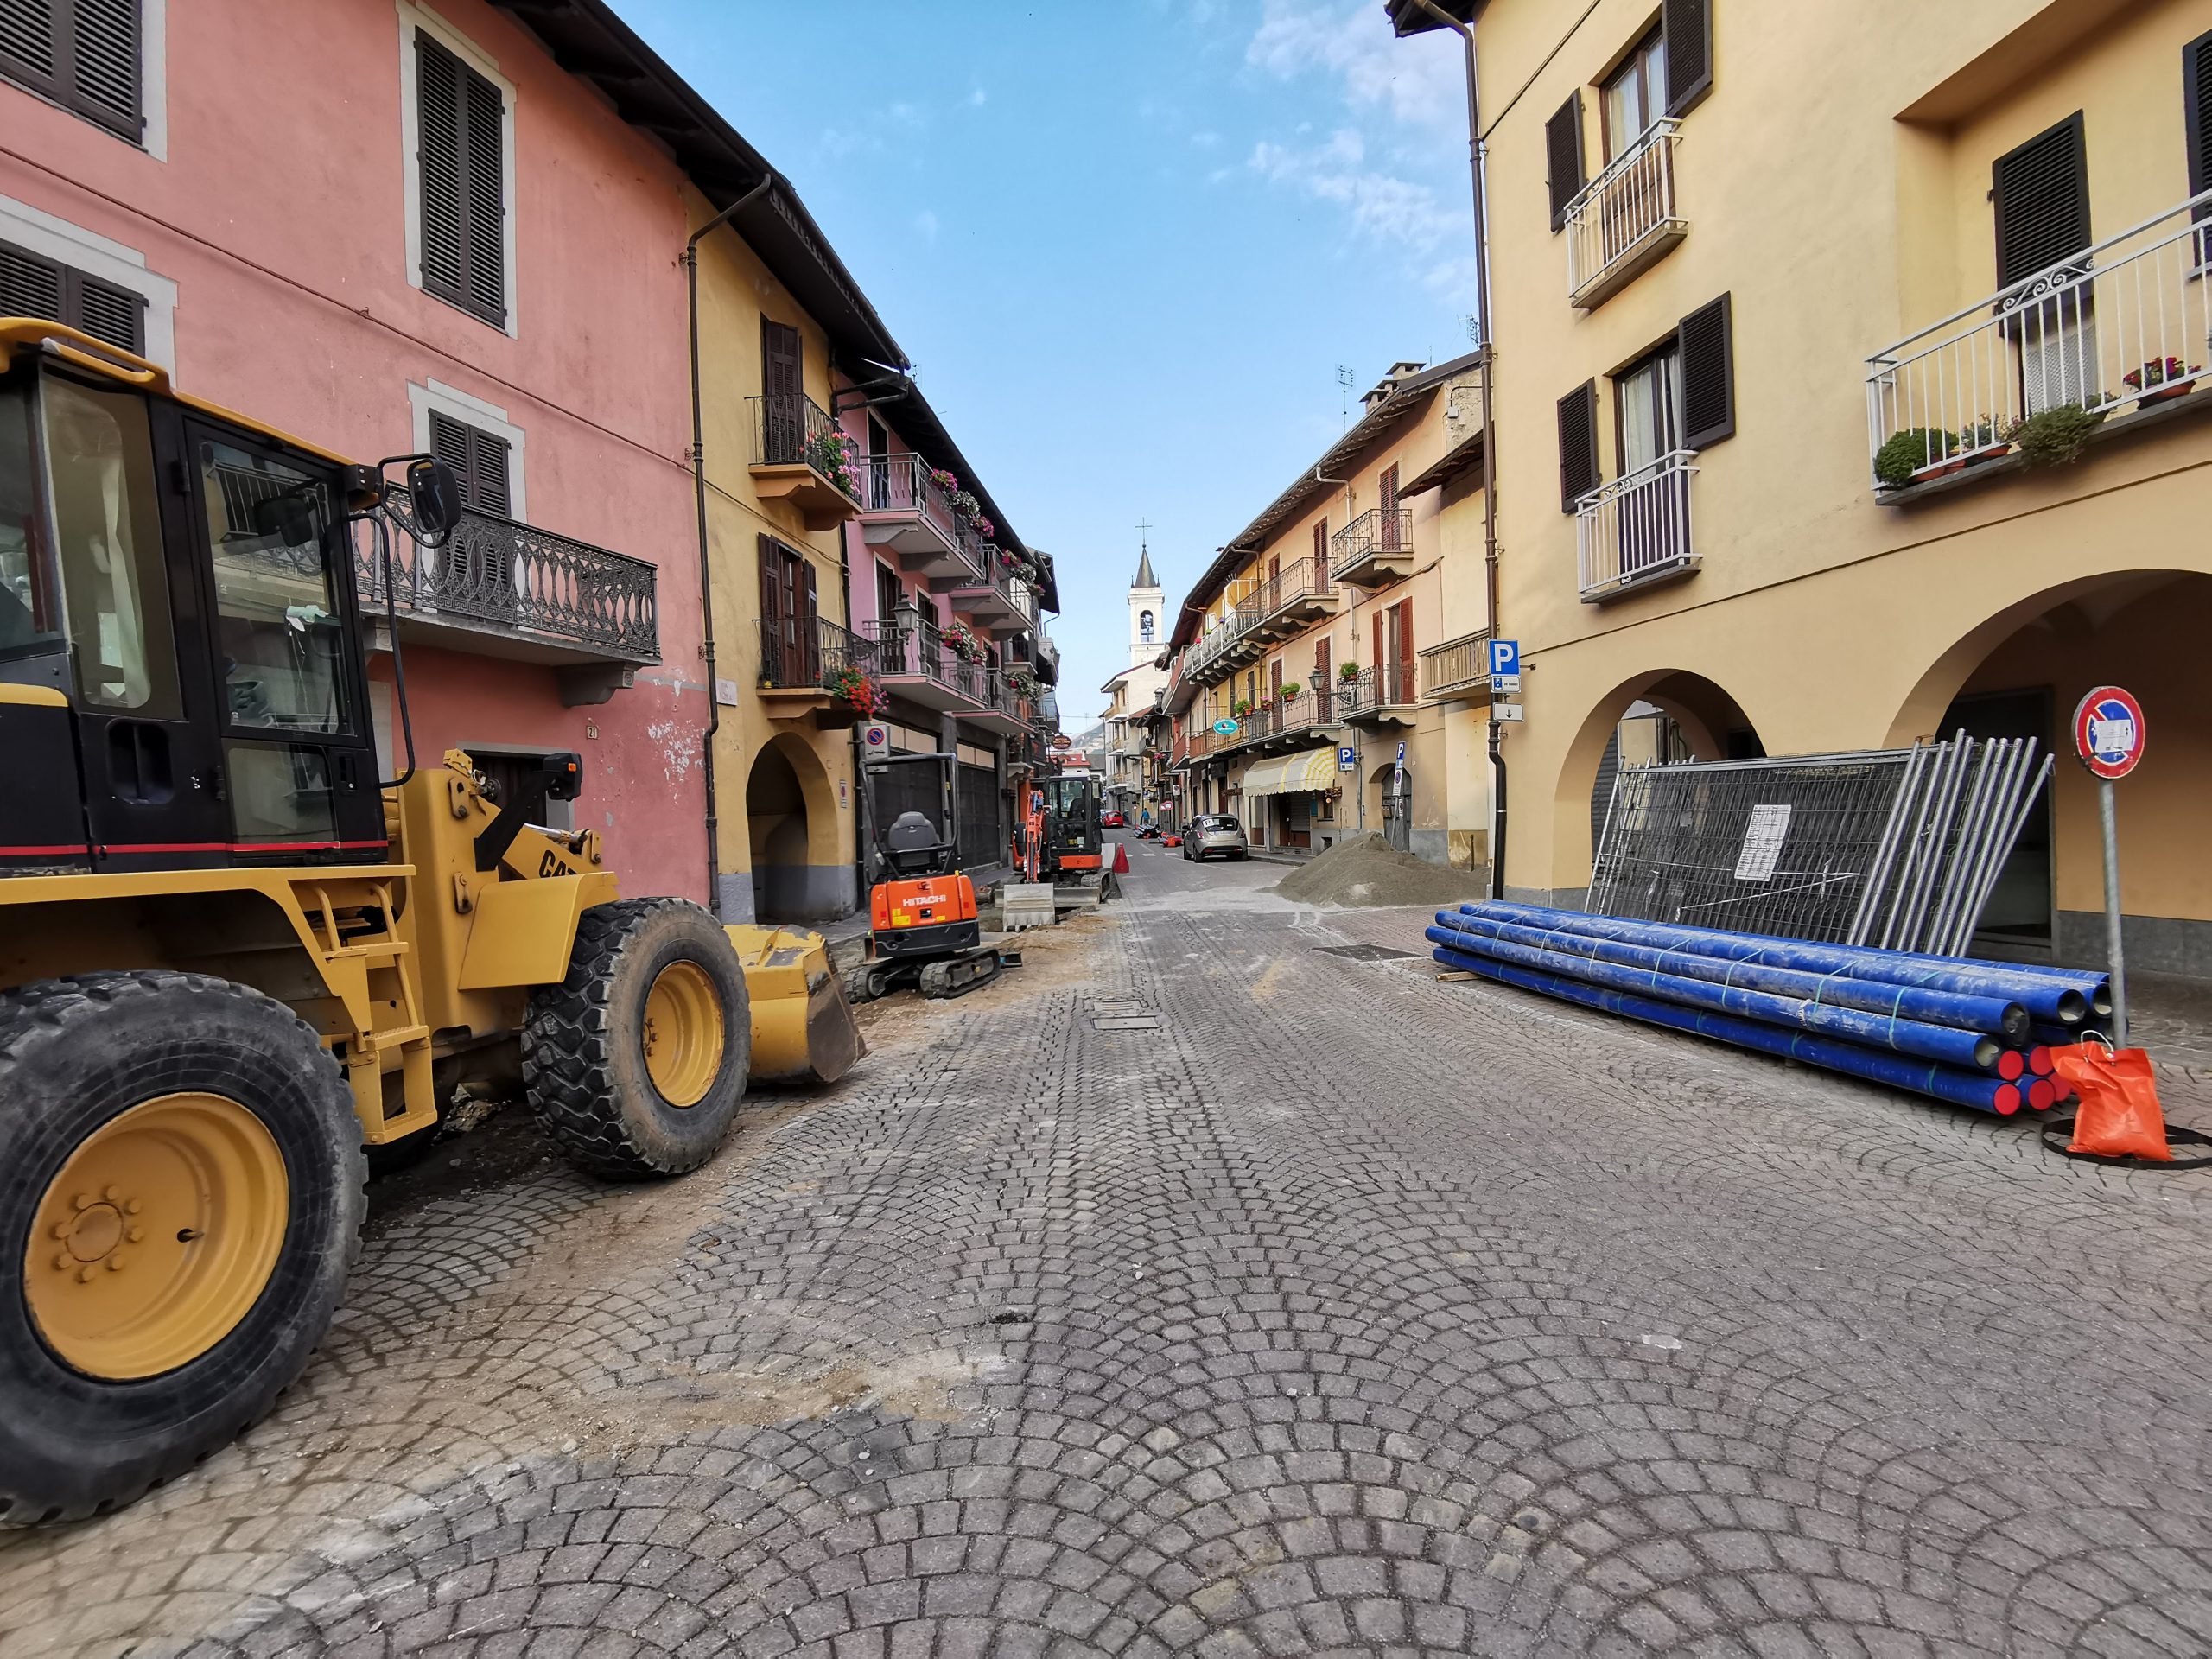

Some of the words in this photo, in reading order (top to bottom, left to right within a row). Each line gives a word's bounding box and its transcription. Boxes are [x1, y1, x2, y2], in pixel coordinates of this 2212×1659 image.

[1494, 643, 1514, 672] P
[1342, 749, 1351, 762] P
[1397, 743, 1403, 759] P
[538, 849, 578, 879] CA
[902, 894, 947, 907] HITACHI
